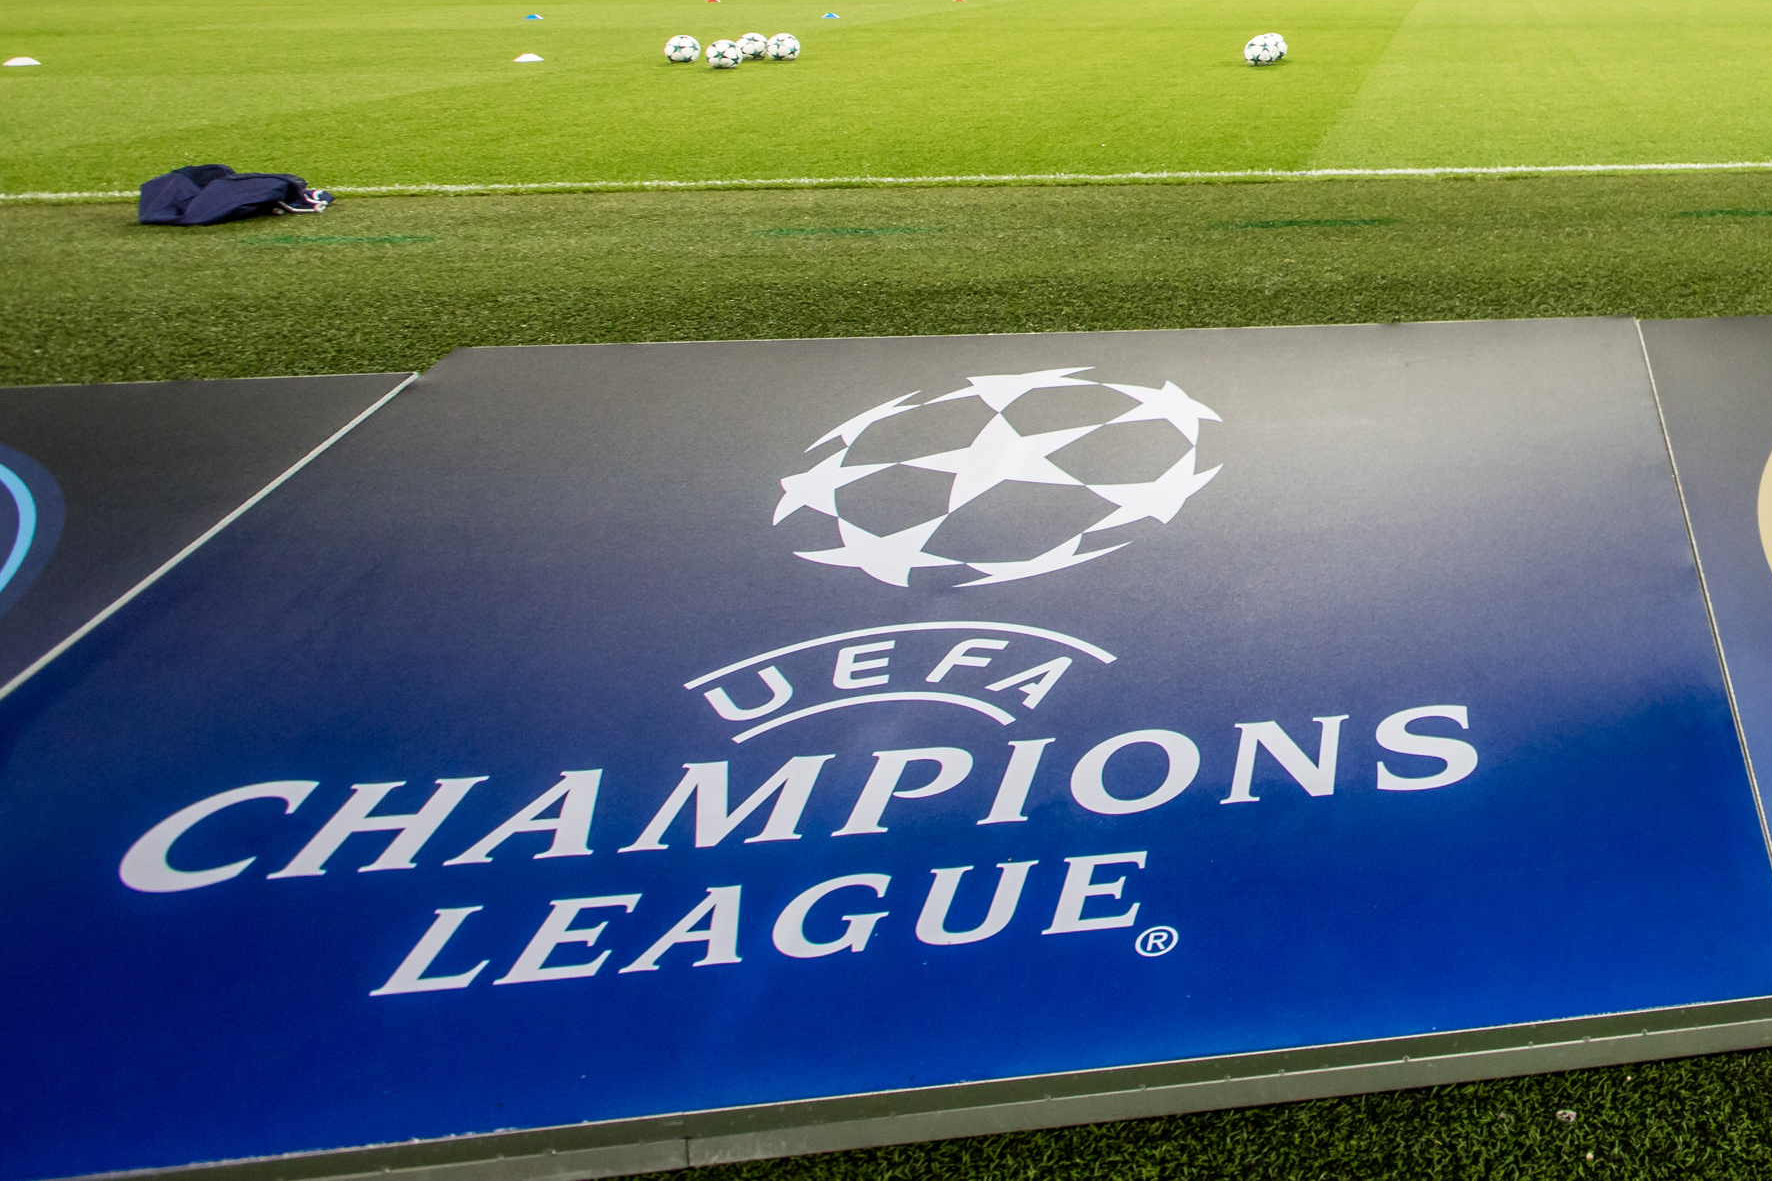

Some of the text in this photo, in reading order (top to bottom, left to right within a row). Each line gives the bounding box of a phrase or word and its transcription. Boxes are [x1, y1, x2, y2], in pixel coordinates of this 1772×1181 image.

[703, 638, 1073, 721] UEFA
[119, 704, 1478, 892] CHAMPIONS
[369, 851, 1147, 996] LEAGUE
